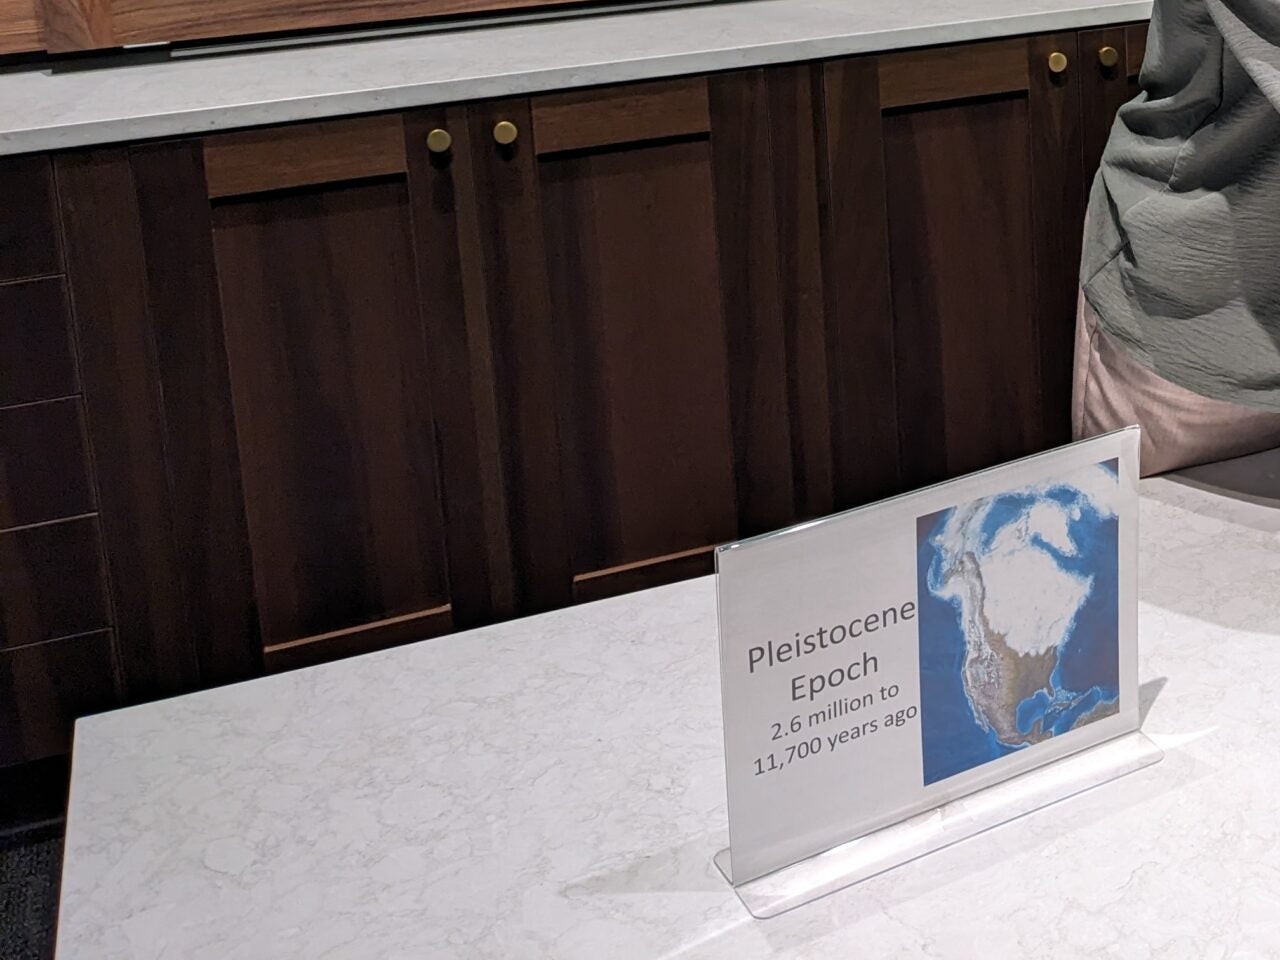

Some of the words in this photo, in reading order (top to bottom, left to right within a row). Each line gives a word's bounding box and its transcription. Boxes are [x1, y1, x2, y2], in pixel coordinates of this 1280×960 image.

[748, 601, 916, 674] Pleistocene
[791, 652, 878, 701] Epoch
[754, 737, 822, 776] 11,700
[827, 719, 878, 751] years
[884, 705, 918, 727] ago
[771, 715, 802, 741] 2.6
[808, 693, 873, 727] million
[880, 684, 899, 701] to
